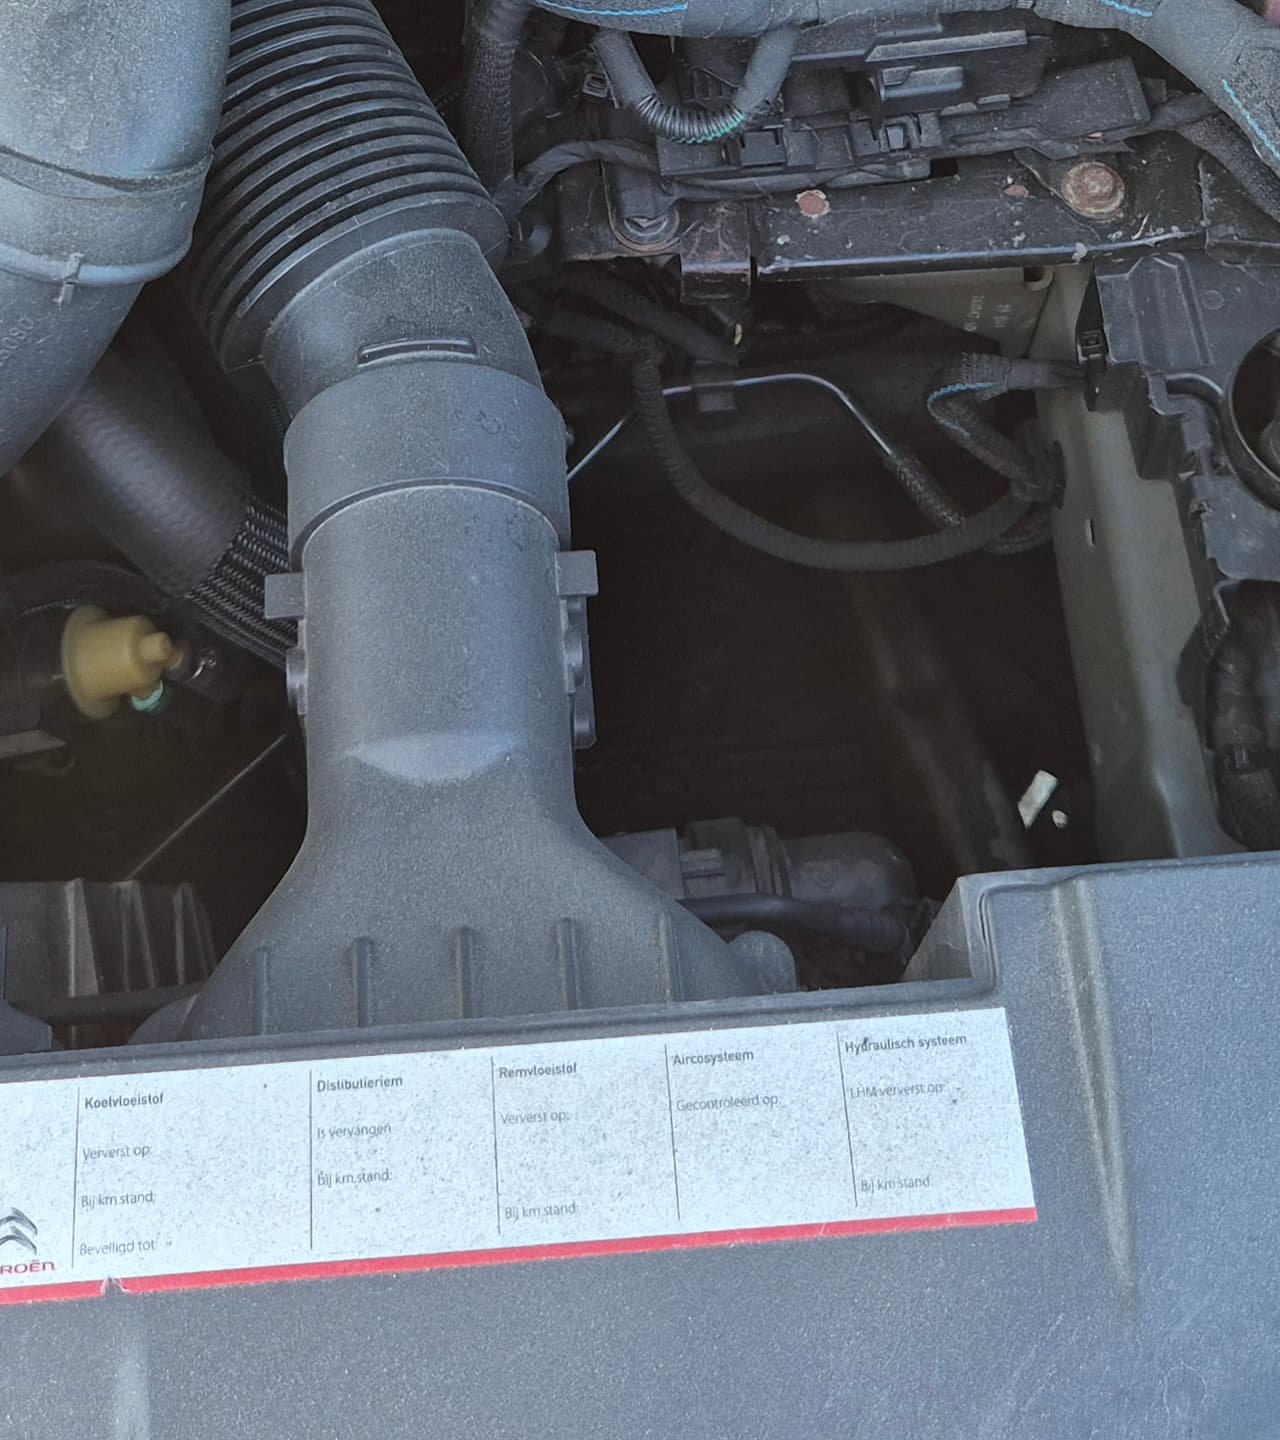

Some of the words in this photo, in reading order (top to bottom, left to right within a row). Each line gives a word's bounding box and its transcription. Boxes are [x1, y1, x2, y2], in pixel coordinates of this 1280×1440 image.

[844, 1036, 916, 1056] Hydraulisch
[918, 1034, 968, 1051] systeem
[672, 1050, 755, 1067] Aircosysteem
[499, 1061, 578, 1079] Remvloeistof
[84, 1091, 165, 1111] Koelvloeistof
[675, 1094, 760, 1112] Gecontroleerd
[500, 1111, 548, 1125] Ververst
[328, 1121, 393, 1139] vervangen
[82, 1144, 130, 1161] Ververst
